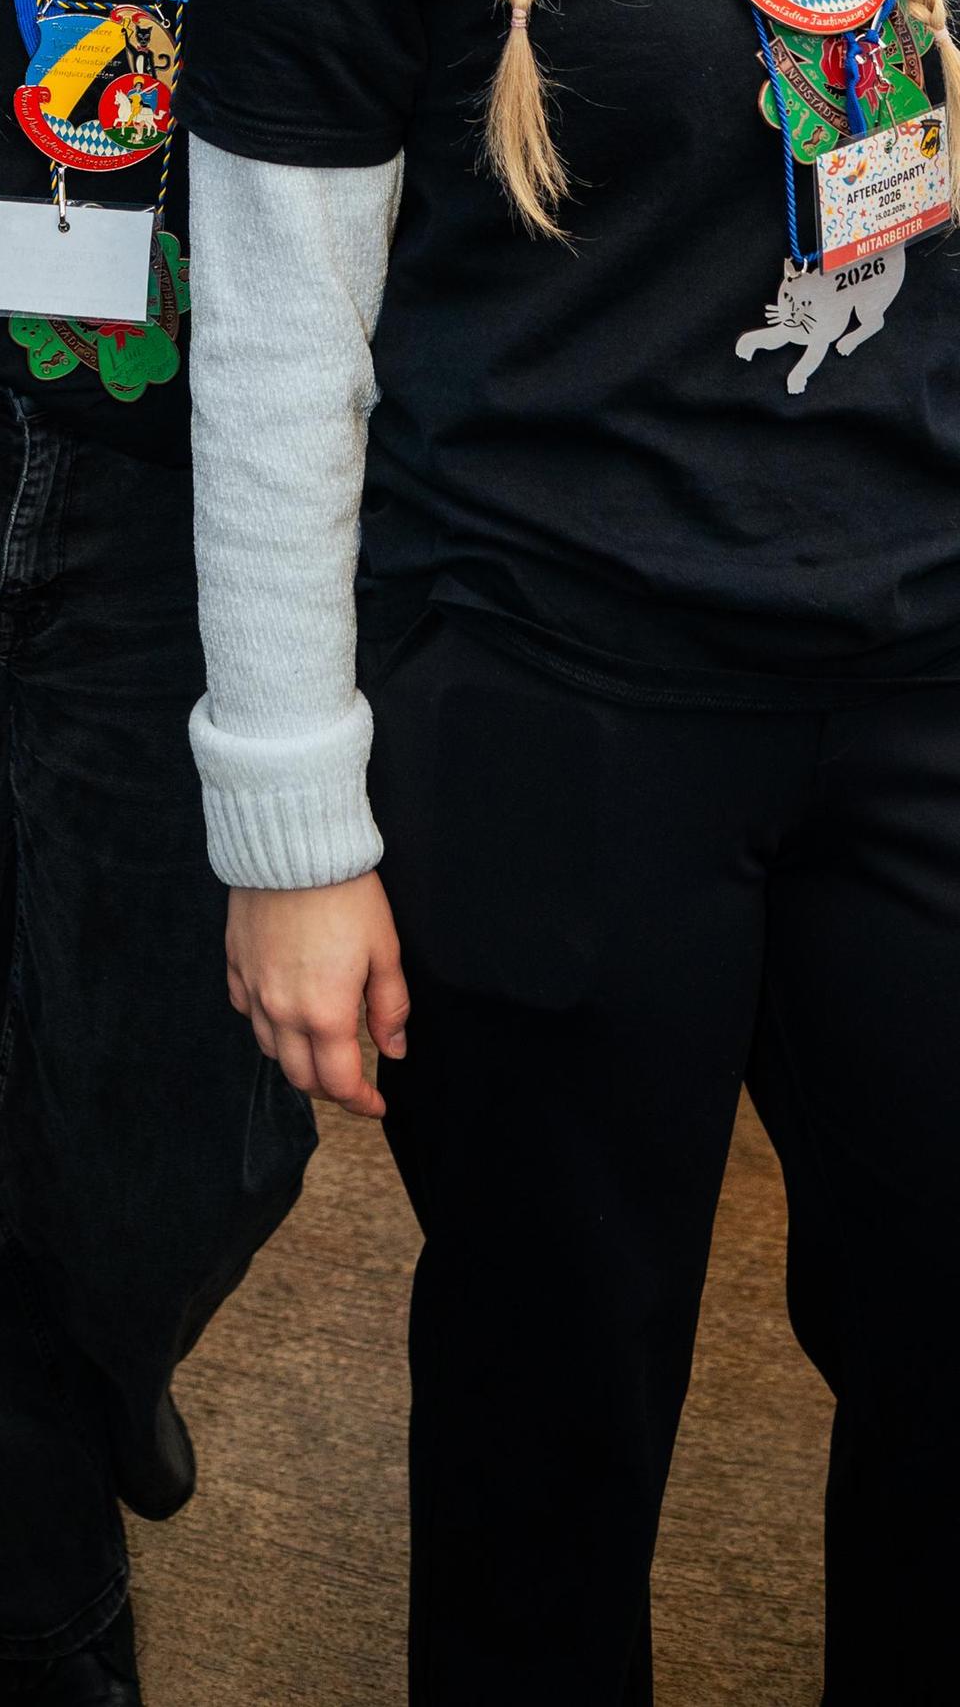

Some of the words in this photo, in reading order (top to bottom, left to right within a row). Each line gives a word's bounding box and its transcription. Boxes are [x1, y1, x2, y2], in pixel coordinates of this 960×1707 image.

[786, 67, 840, 124] NEUSTADT
[846, 163, 927, 206] AFTERZUGPARTY
[878, 189, 902, 208] 2026
[857, 218, 923, 257] MITARBEITER
[835, 257, 886, 292] 2026
